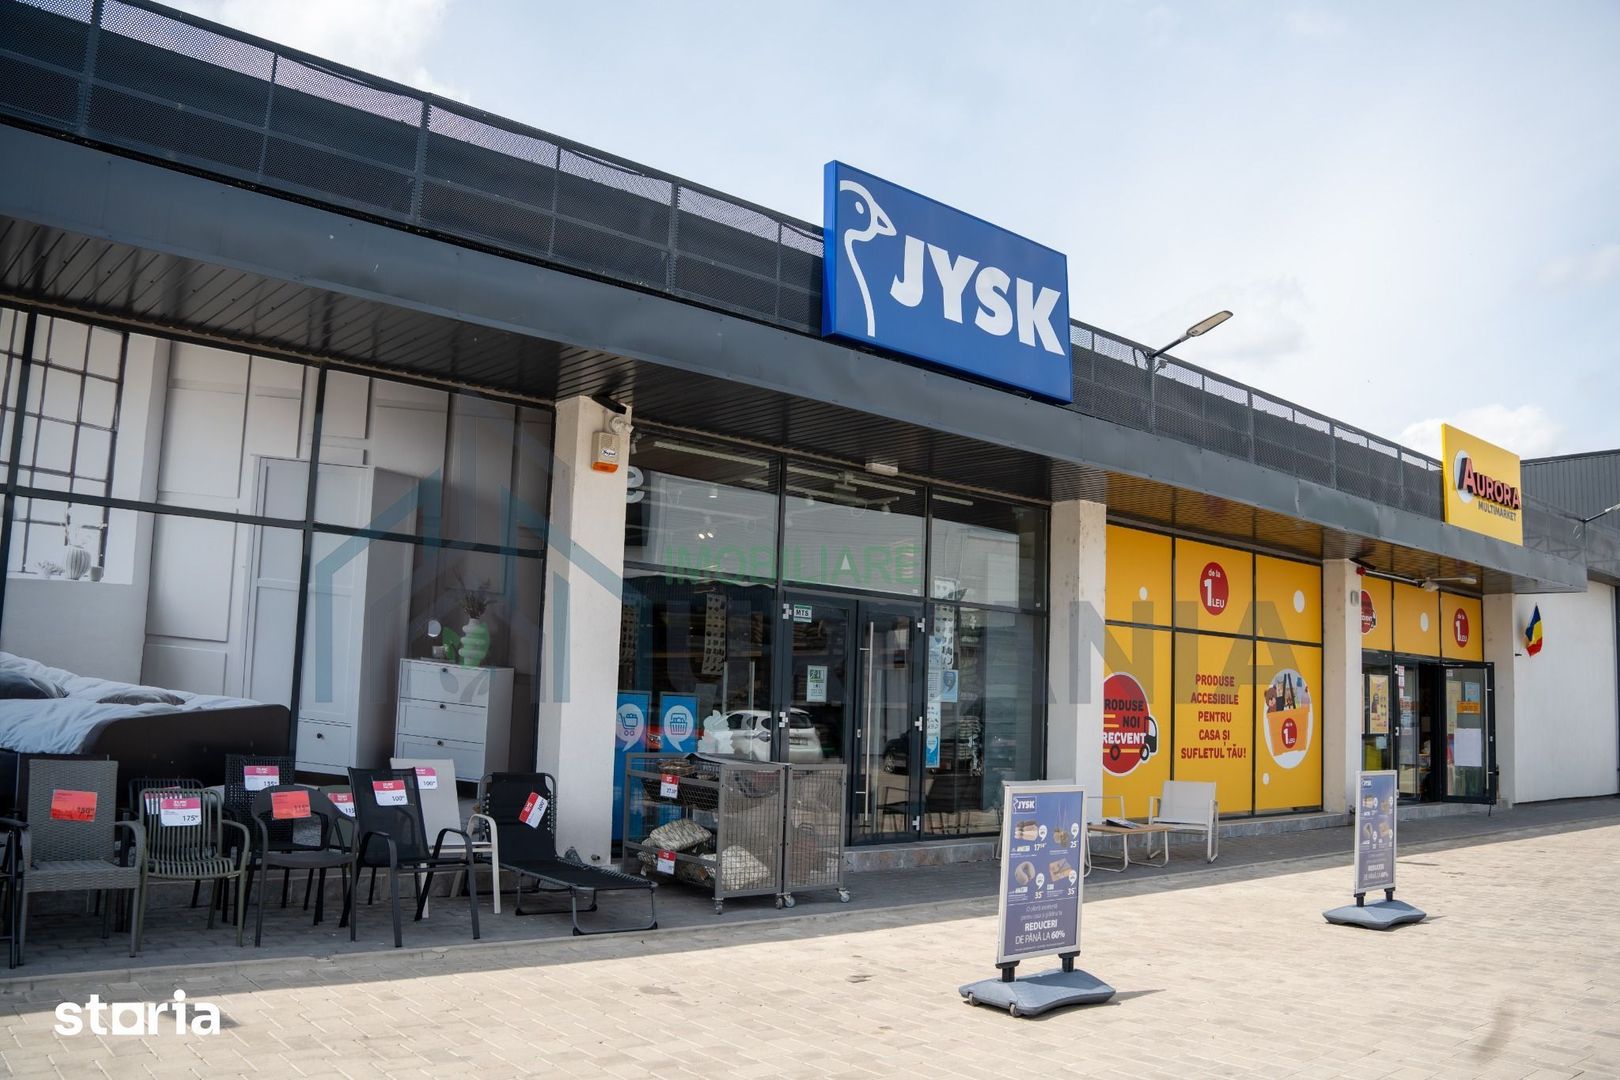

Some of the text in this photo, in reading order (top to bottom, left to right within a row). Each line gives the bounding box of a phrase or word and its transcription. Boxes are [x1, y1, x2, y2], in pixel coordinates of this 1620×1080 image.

[890, 235, 1066, 356] JYSK
[1459, 457, 1521, 509] AURORA
[1478, 501, 1517, 522] MULTIMARKET
[1204, 579, 1212, 607] 1
[1212, 599, 1225, 609] LEU
[795, 609, 809, 617] MTS
[1195, 673, 1235, 688] PRODUSE
[1104, 698, 1144, 712] RODUSE
[1190, 692, 1239, 705] ACCESIBILE
[1122, 715, 1140, 728] NOI
[1198, 711, 1232, 723] PENTRU
[1103, 731, 1147, 745] RECVENT
[1199, 729, 1221, 741] CASA
[1181, 747, 1225, 760] SUFLETUL
[1017, 799, 1035, 809] JYSK
[1024, 919, 1058, 932] REDUCERI
[1015, 935, 1024, 945] DE
[1042, 931, 1050, 941] LA
[1051, 930, 1066, 940] 60%
